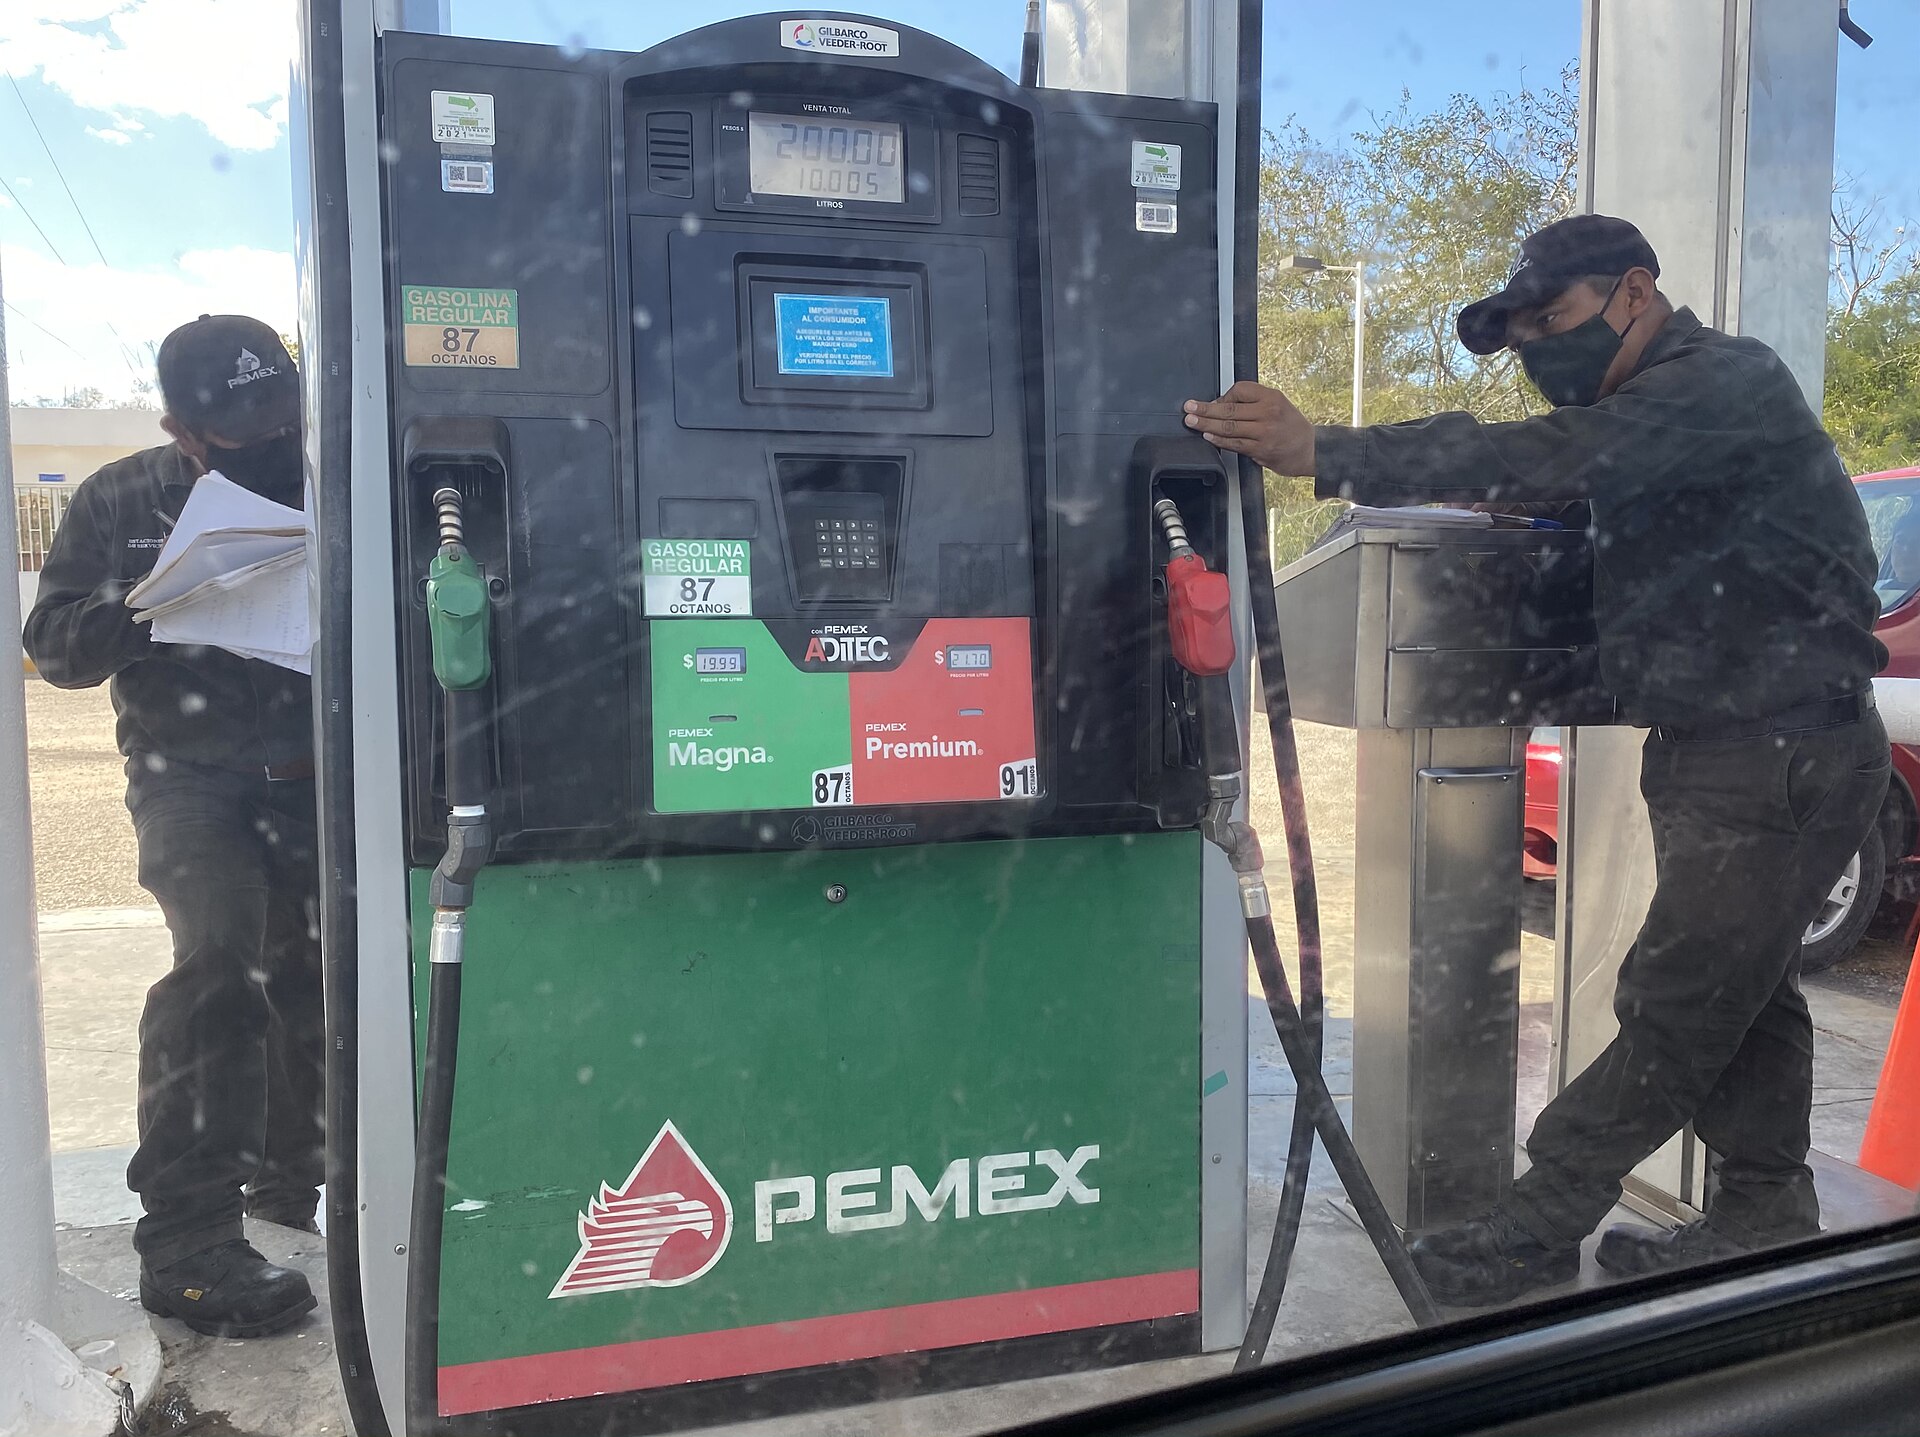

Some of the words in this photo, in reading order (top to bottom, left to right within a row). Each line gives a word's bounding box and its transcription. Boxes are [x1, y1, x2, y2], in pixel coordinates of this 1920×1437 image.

[818, 26, 868, 39] GILBARCO
[819, 38, 888, 52] VEEDER-ROOT
[802, 103, 828, 113] VENTA
[828, 105, 852, 115] TOTAL
[438, 130, 467, 139] 2021
[777, 123, 897, 167] 200.00
[800, 168, 878, 195] 10.005
[816, 200, 844, 209] LITROS
[408, 289, 512, 308] GASOLINA
[412, 306, 509, 324] REGULAR
[808, 306, 859, 316] IMPORTANTE
[814, 315, 867, 324] CONSUMIDOR
[442, 327, 480, 352] 87
[431, 354, 497, 365] OCTANOS
[227, 366, 278, 389] PEMEX
[647, 542, 745, 558] GASOLINA
[651, 559, 743, 573] REGULAR
[680, 577, 716, 602] 87
[669, 603, 732, 614] OCTANOS
[824, 625, 868, 634] PEMEX
[683, 653, 694, 669] $
[703, 657, 737, 670] 19.99
[934, 650, 944, 665] $
[952, 653, 987, 666] 21.70
[668, 728, 713, 738] PEMEX
[865, 723, 907, 732] PEMEX
[866, 735, 977, 760] Premium
[669, 741, 767, 772] Magna
[814, 772, 844, 804] 87
[1001, 765, 1030, 796] 91
[823, 814, 894, 827] GILBARCO
[824, 827, 916, 841] VEEDER-ROOT
[754, 1143, 1100, 1243] PEMEX
